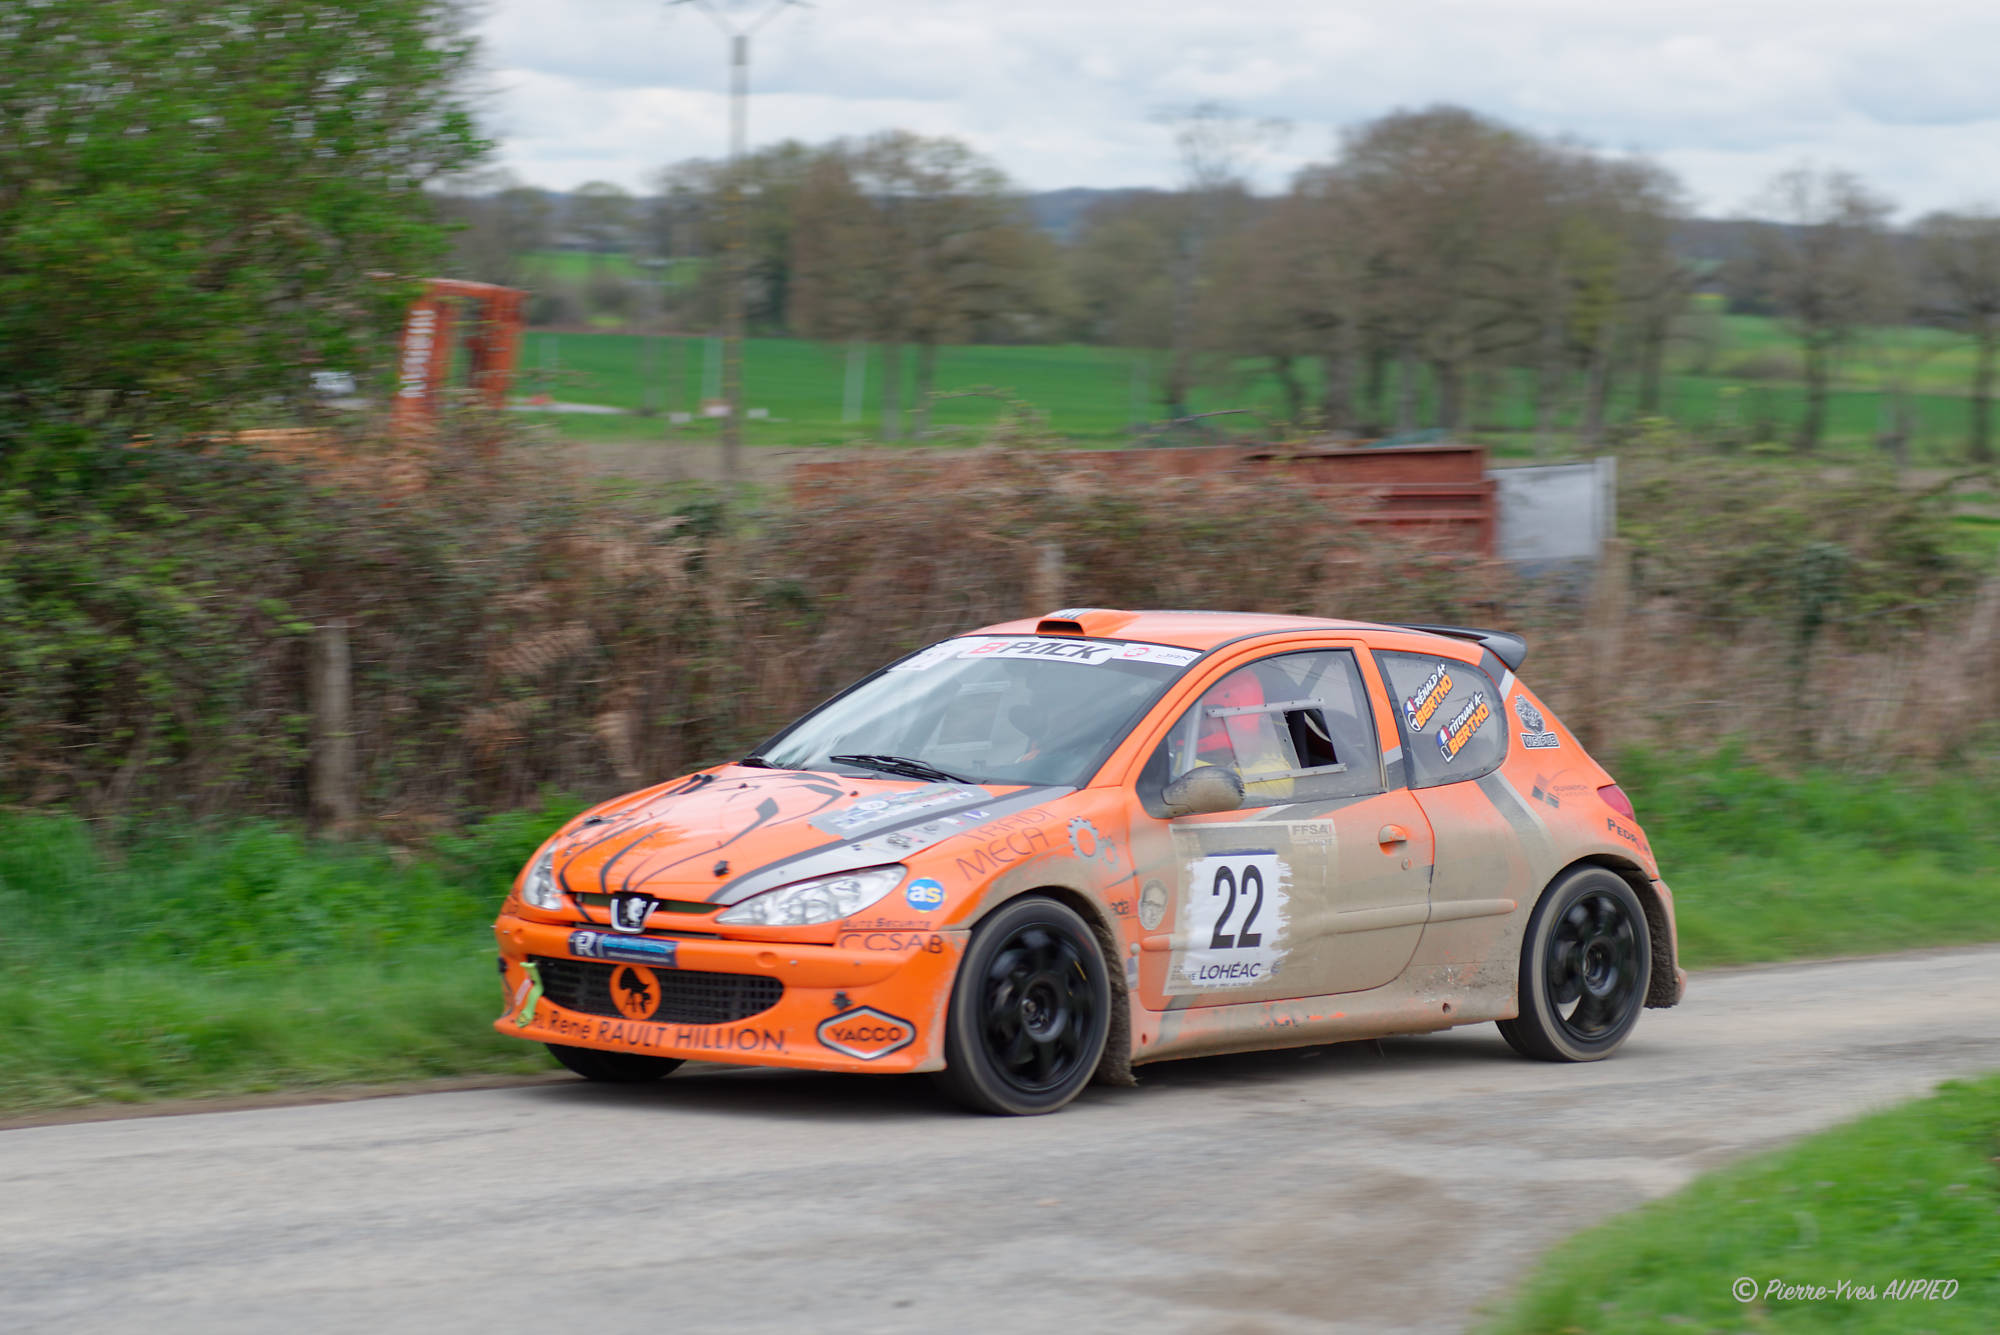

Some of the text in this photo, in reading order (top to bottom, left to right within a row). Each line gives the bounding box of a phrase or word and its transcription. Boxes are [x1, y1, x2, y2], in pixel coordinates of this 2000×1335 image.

[1415, 674, 1453, 729] BERTHO
[1448, 703, 1490, 756] BERTHO
[1292, 824, 1329, 836] FFSA
[955, 826, 1050, 881] MECA
[908, 886, 941, 903] as
[1209, 864, 1264, 950] 22
[1199, 961, 1261, 980] LOHÉAC
[551, 1008, 592, 1040] René
[597, 1020, 668, 1048] RAULT
[831, 1027, 902, 1042] YACCO
